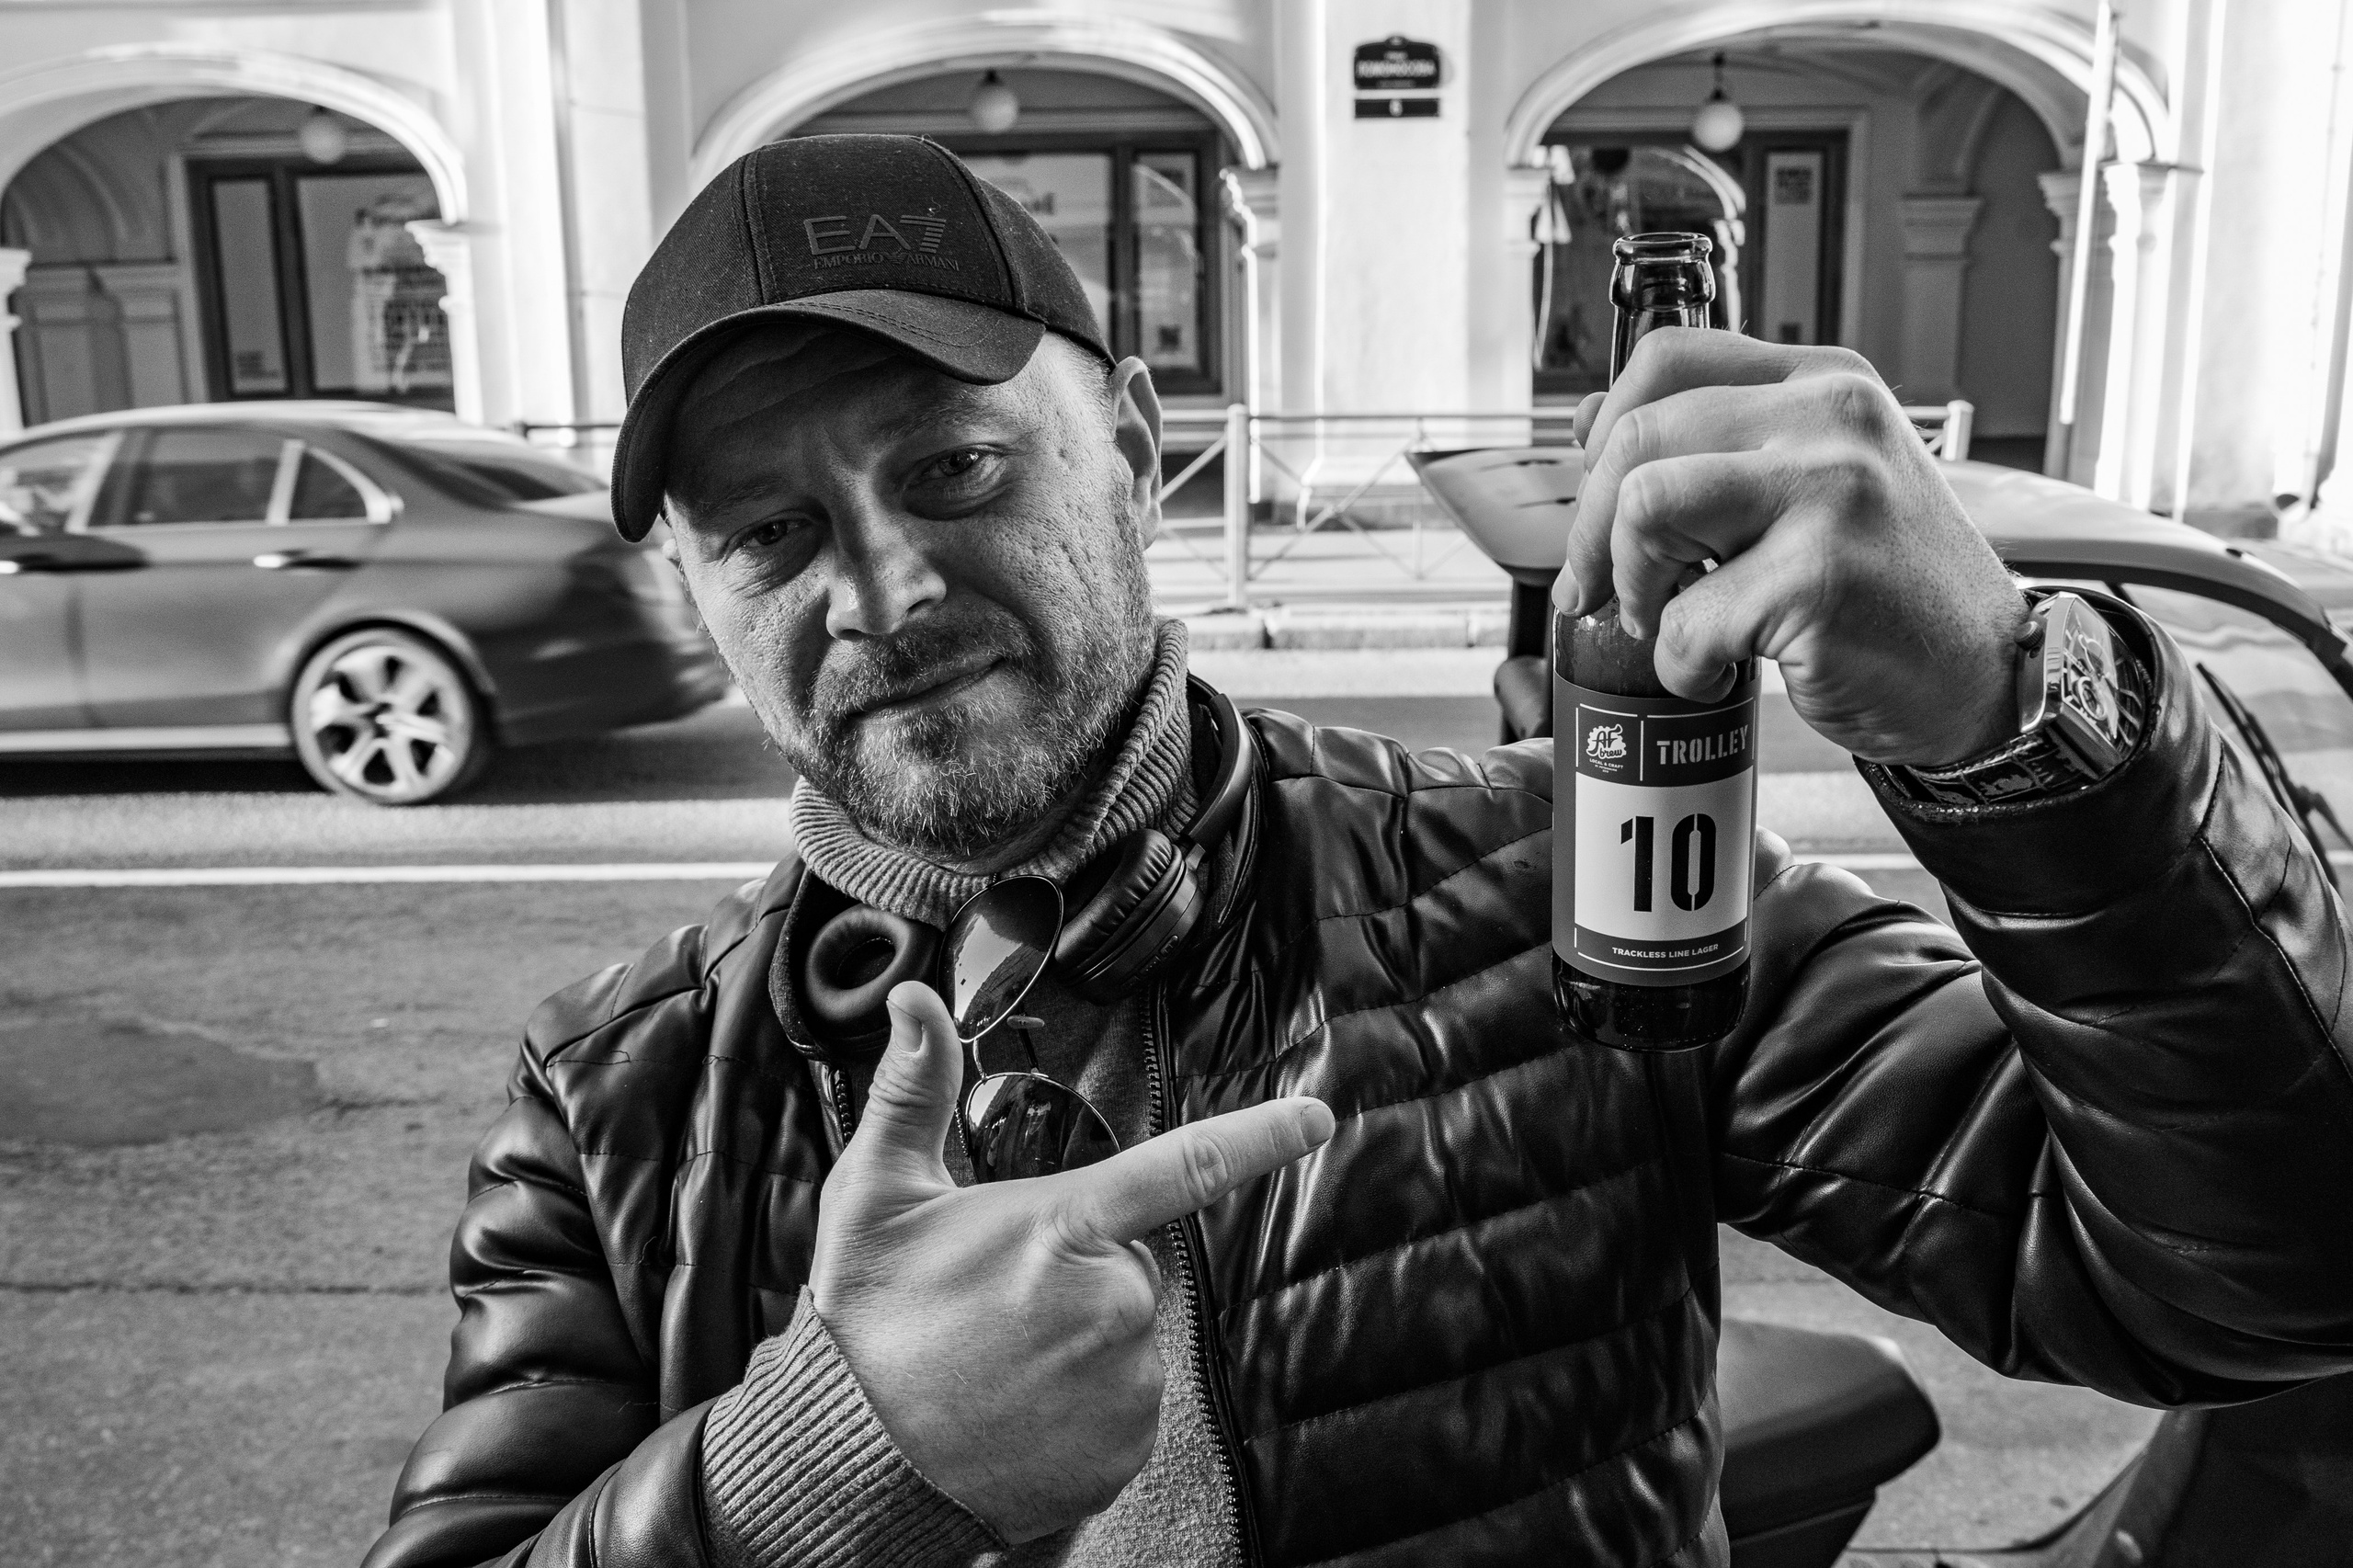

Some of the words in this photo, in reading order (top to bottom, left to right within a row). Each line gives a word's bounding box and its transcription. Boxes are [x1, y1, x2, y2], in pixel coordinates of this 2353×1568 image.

[803, 214, 947, 256] EA7
[813, 252, 884, 270] EMPORIO
[906, 254, 960, 271] ARMANI
[1599, 747, 1622, 757] brew
[1656, 724, 1749, 765] TROLLEY
[1620, 812, 1716, 913] 10
[1611, 947, 1666, 959] TRACKLESS
[1668, 949, 1689, 959] LINE
[1691, 943, 1719, 956] LAGER
